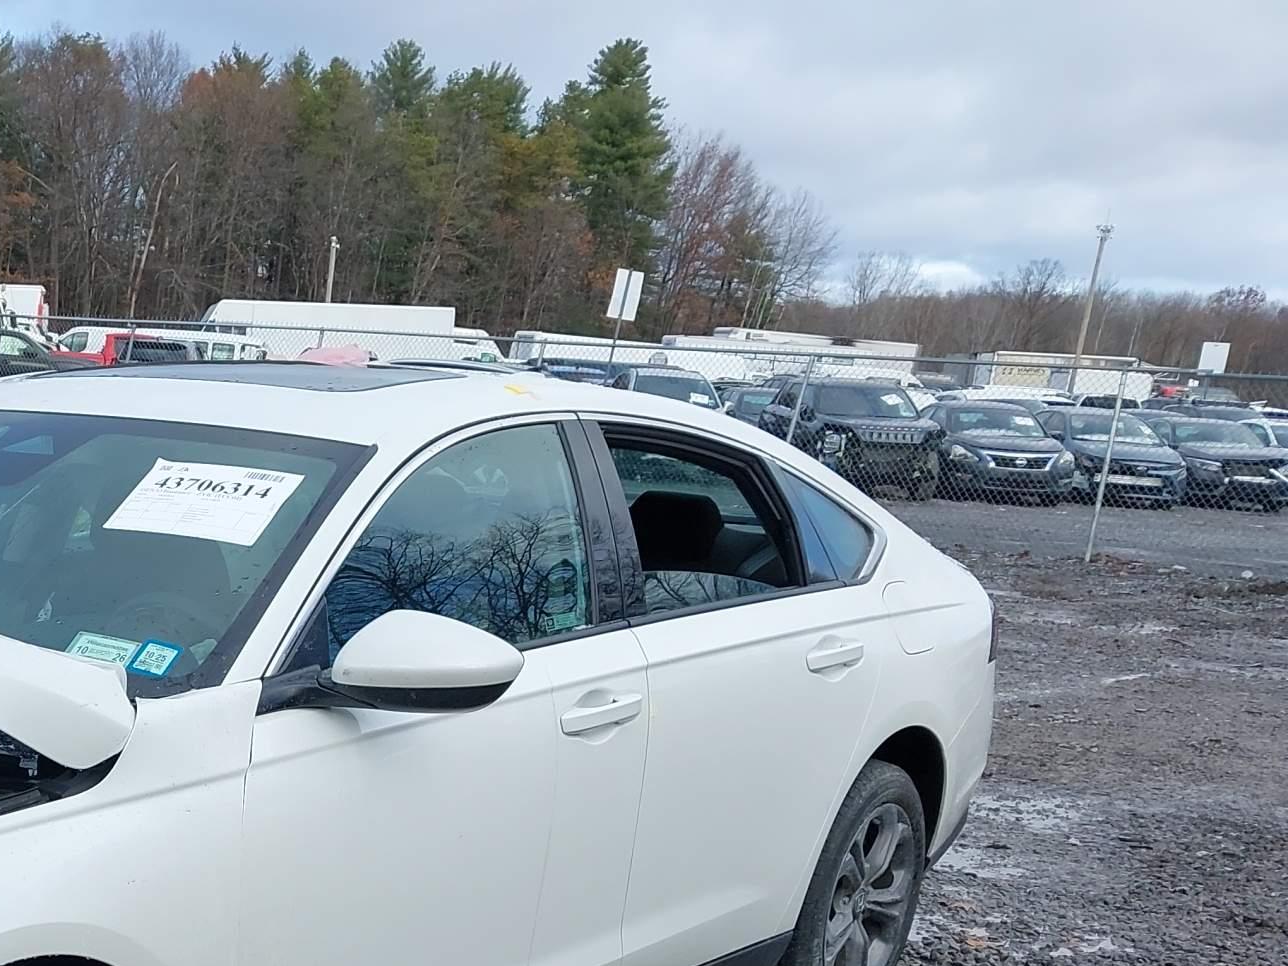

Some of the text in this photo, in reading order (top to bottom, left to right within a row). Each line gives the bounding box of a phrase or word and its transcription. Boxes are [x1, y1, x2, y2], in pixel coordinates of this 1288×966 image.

[154, 475, 273, 500] 43706314
[75, 645, 89, 655] 10
[112, 652, 128, 663] 26
[144, 650, 168, 662] 10 25
